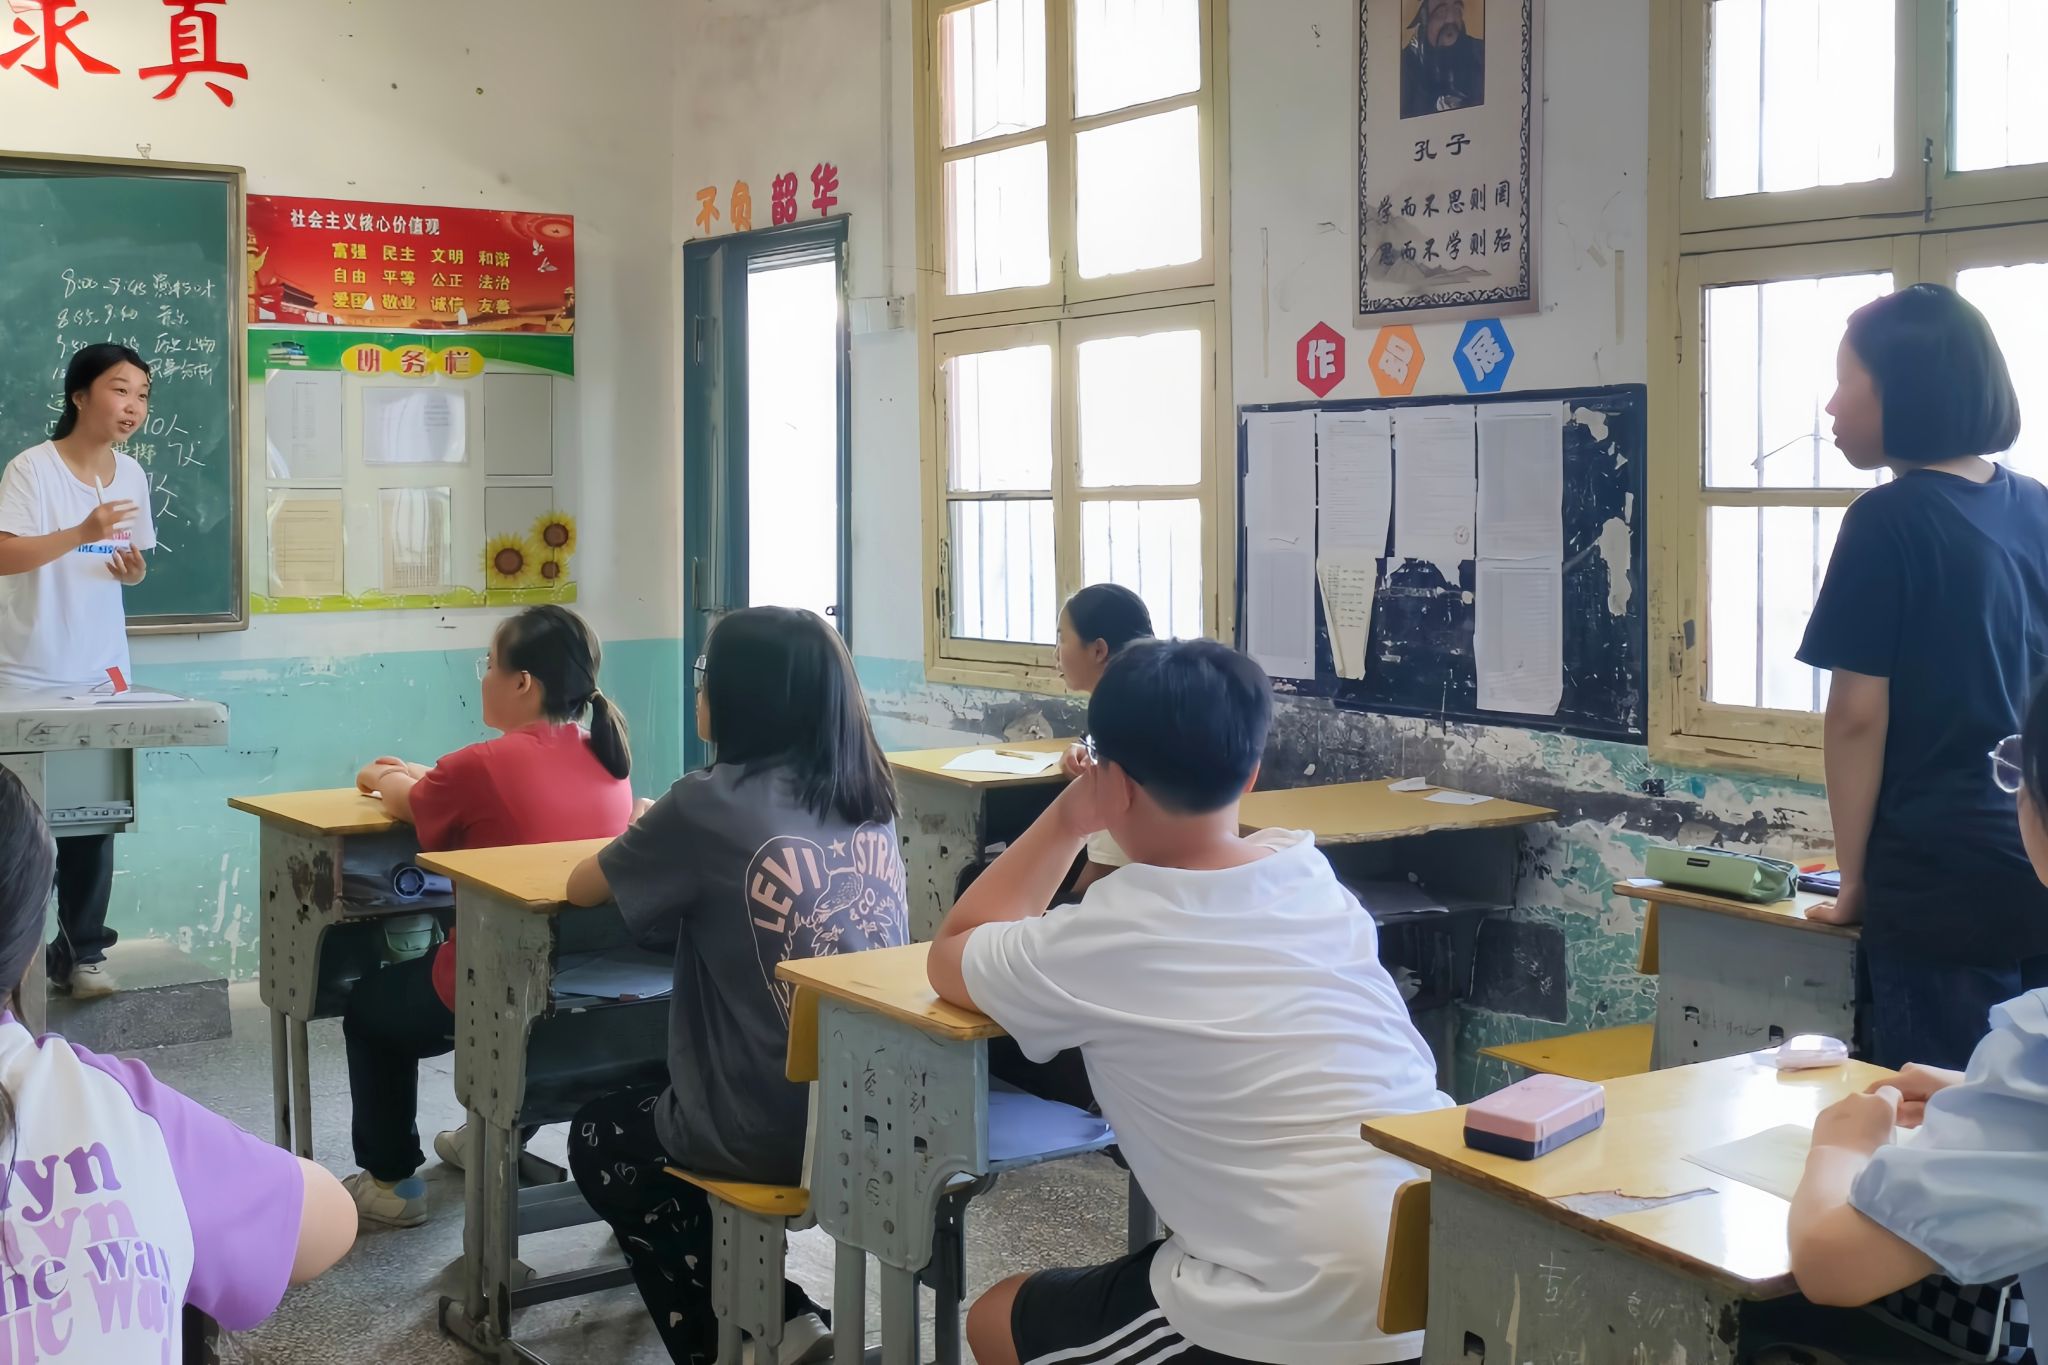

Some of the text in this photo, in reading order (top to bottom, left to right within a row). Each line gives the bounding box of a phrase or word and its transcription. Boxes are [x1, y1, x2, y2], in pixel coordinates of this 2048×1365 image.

[1412, 132, 1472, 162] 孔子
[1377, 179, 1512, 225] 学而不思则罔
[290, 208, 440, 236] 社会主义核心价值观
[332, 242, 510, 268] 富强 民主 文明 和谐
[1378, 226, 1513, 267] 思而不学则殆
[334, 267, 511, 291] 自由 平等 公正 法治
[332, 291, 511, 315] 爱国 敬业 诚信 友善
[750, 847, 822, 934] LEVI
